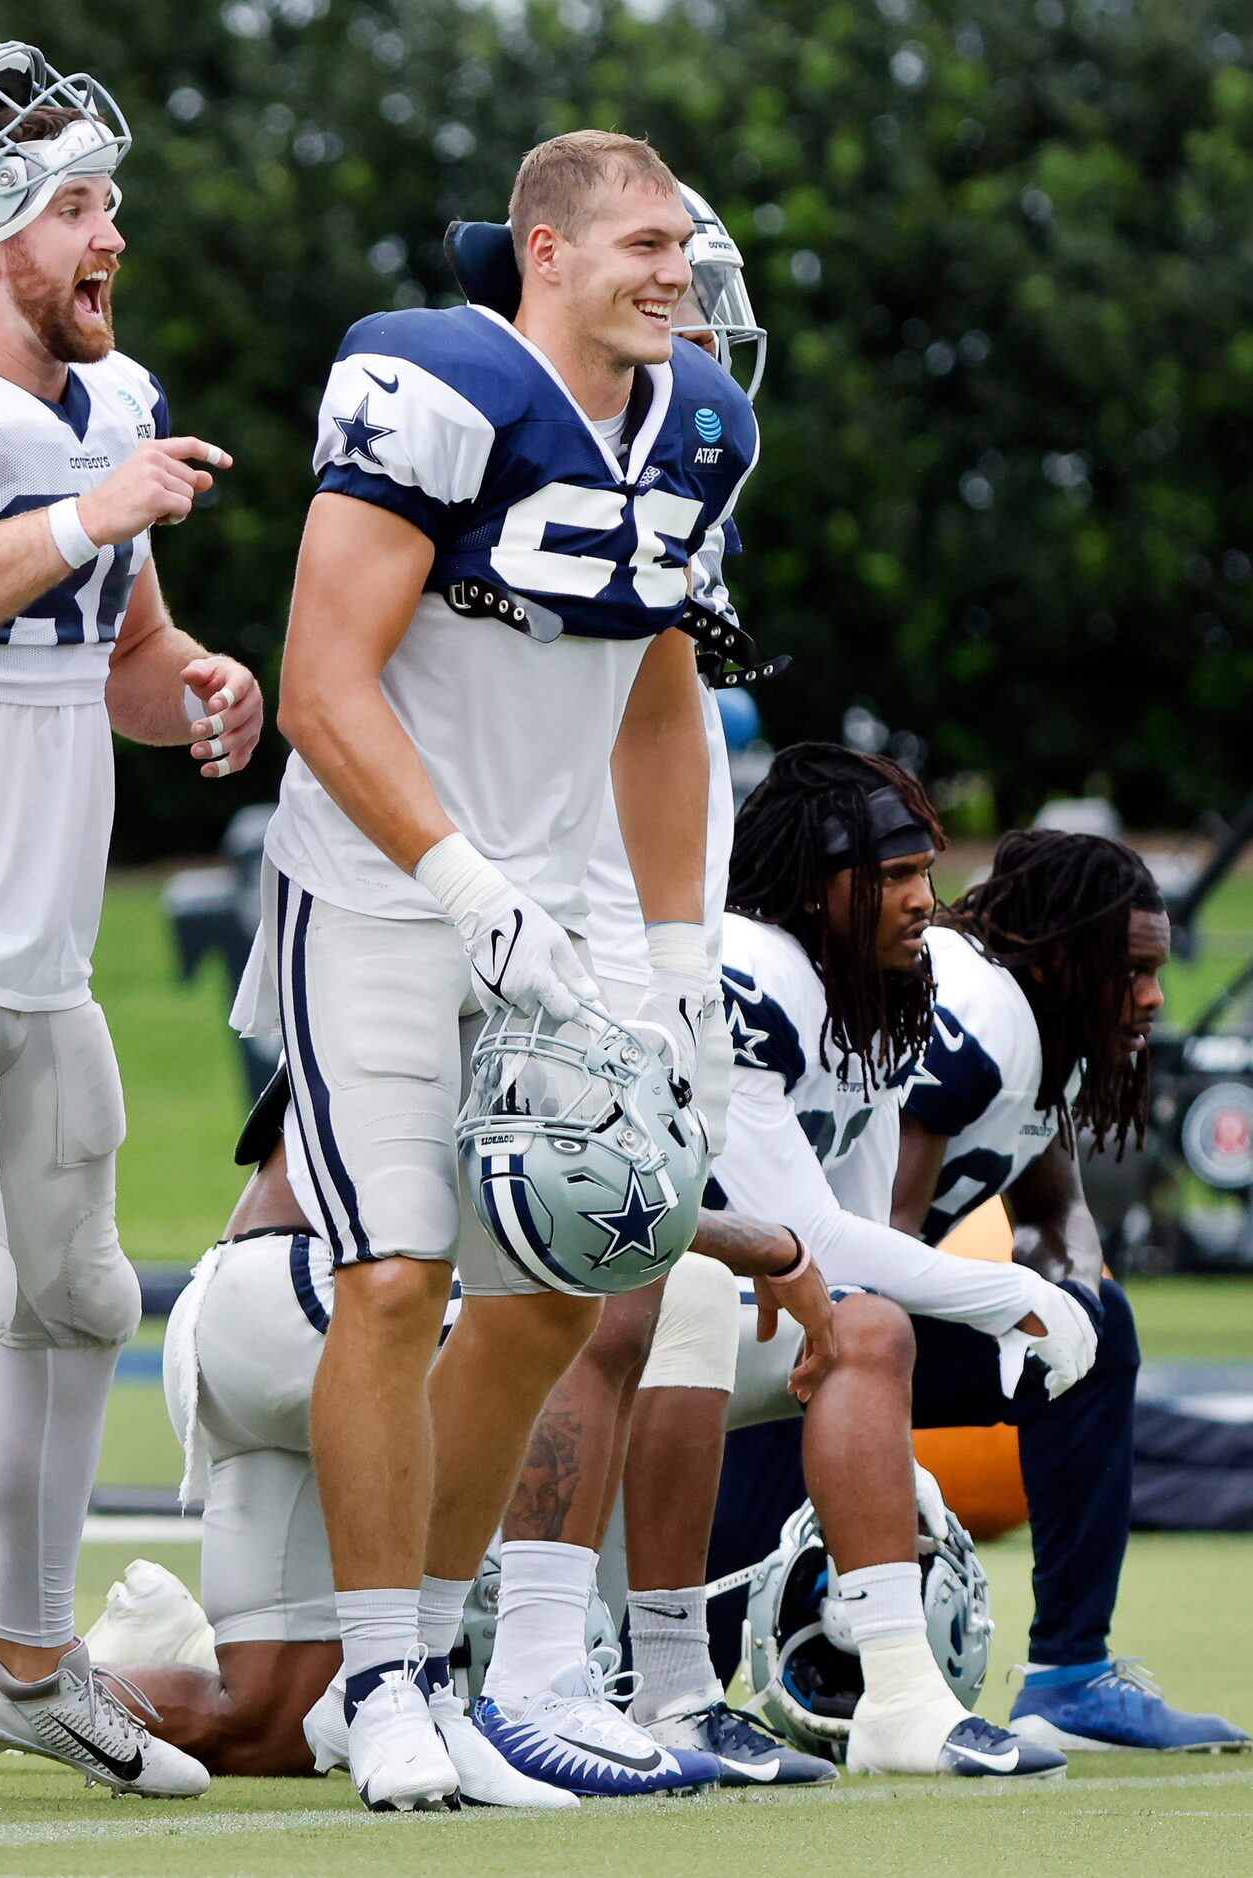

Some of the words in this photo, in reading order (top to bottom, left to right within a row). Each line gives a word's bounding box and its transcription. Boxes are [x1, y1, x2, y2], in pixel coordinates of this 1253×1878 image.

[136, 423, 152, 440] AT&T
[69, 456, 110, 470] COWBOYS
[694, 447, 723, 464] AT&T
[481, 1134, 515, 1146] COWBOYS
